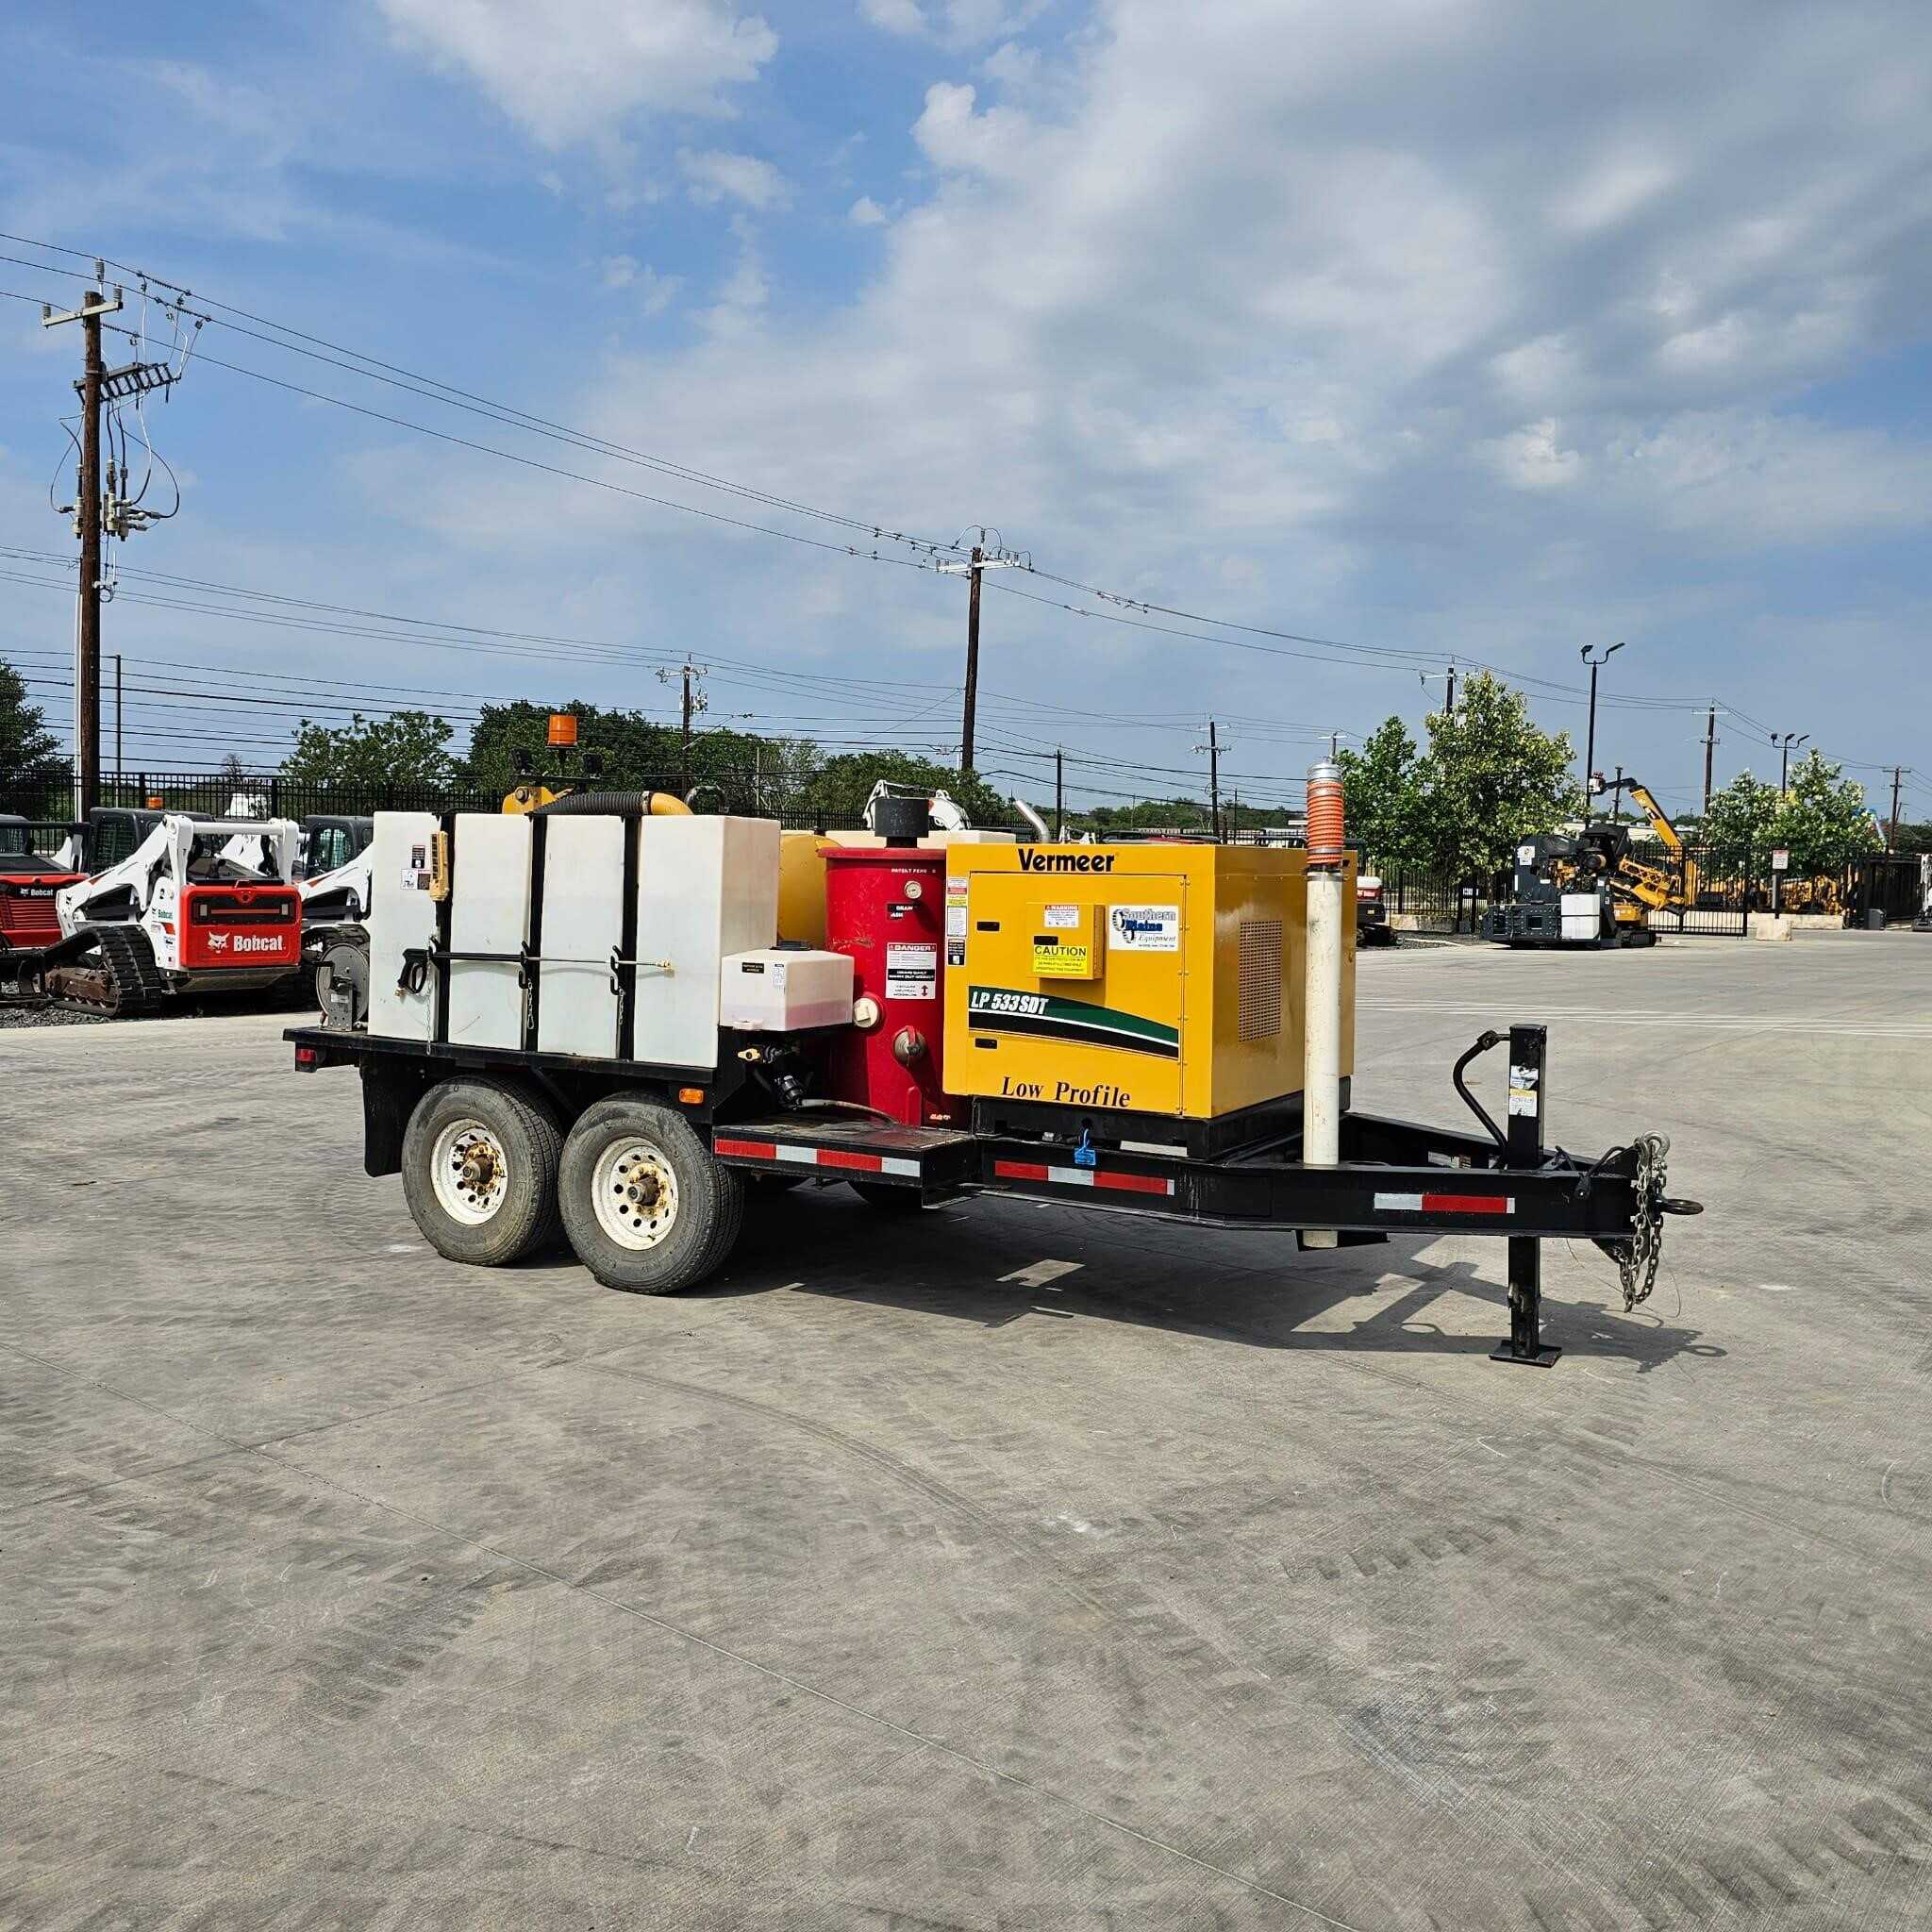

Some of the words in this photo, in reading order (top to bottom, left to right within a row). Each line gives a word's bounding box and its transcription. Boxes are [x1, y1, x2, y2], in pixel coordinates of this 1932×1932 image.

[1018, 848, 1115, 873] Vermeer
[158, 908, 174, 920] Bobcat
[1123, 908, 1176, 922] Southern
[233, 935, 283, 952] Bobcat
[1139, 934, 1176, 943] Equipment
[1034, 945, 1087, 957] CAUTION
[971, 991, 991, 1008] LP
[1001, 1075, 1044, 1098] Low
[1054, 1080, 1131, 1108] Profile
